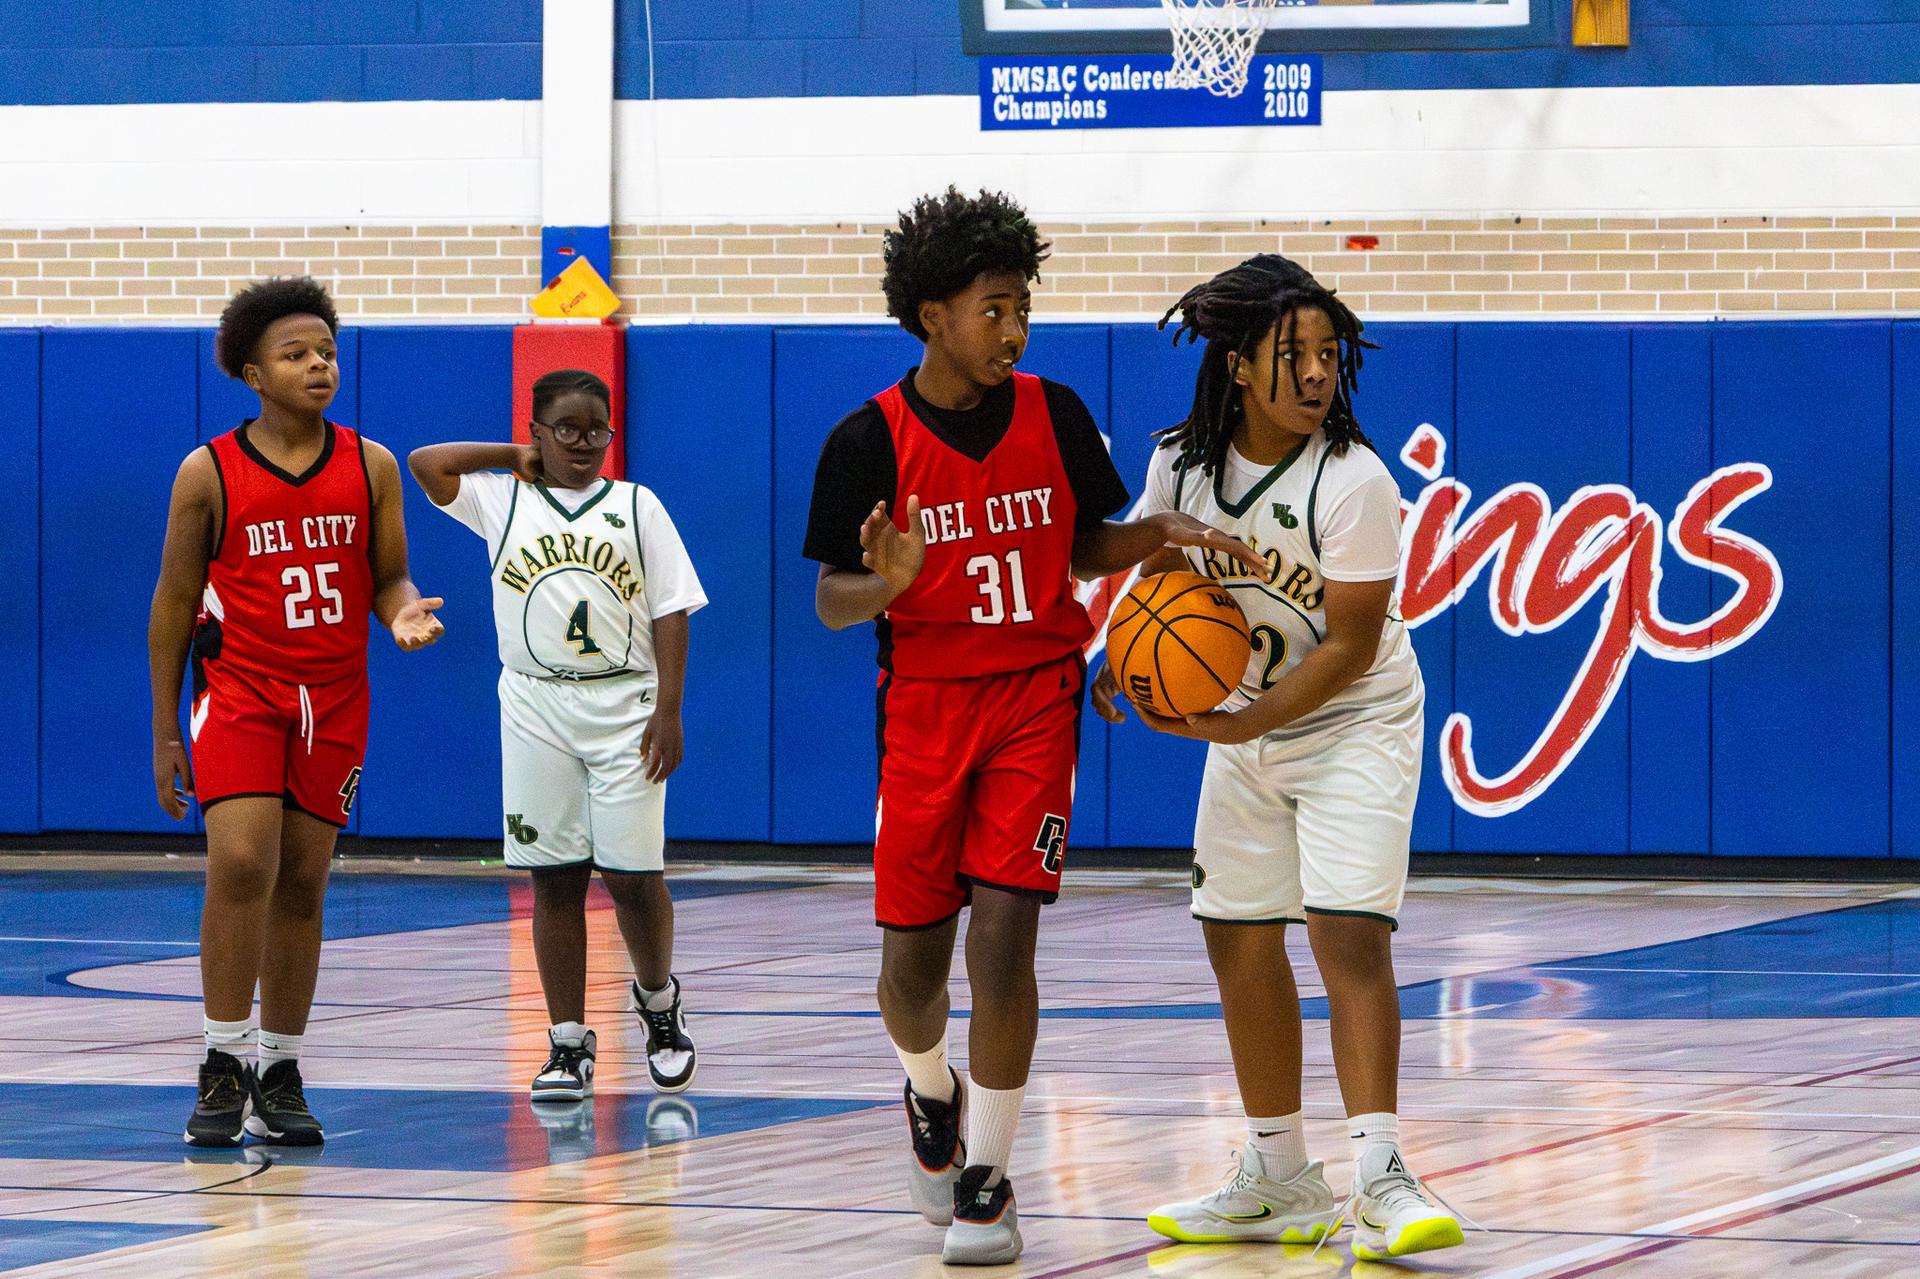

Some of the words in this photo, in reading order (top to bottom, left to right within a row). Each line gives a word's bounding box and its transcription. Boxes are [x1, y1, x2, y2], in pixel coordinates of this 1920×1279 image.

[992, 65, 1077, 93] MMSAC
[1264, 64, 1311, 90] 2009
[994, 94, 1107, 125] Champions
[1264, 91, 1309, 117] 2010
[245, 520, 293, 556] DEL
[302, 514, 357, 548] CITY
[921, 501, 974, 545] DEL
[985, 487, 1052, 534] CITY
[501, 533, 642, 601] WARRIORS
[966, 550, 1034, 624] 31
[281, 562, 344, 629] 25
[564, 597, 601, 658] 4
